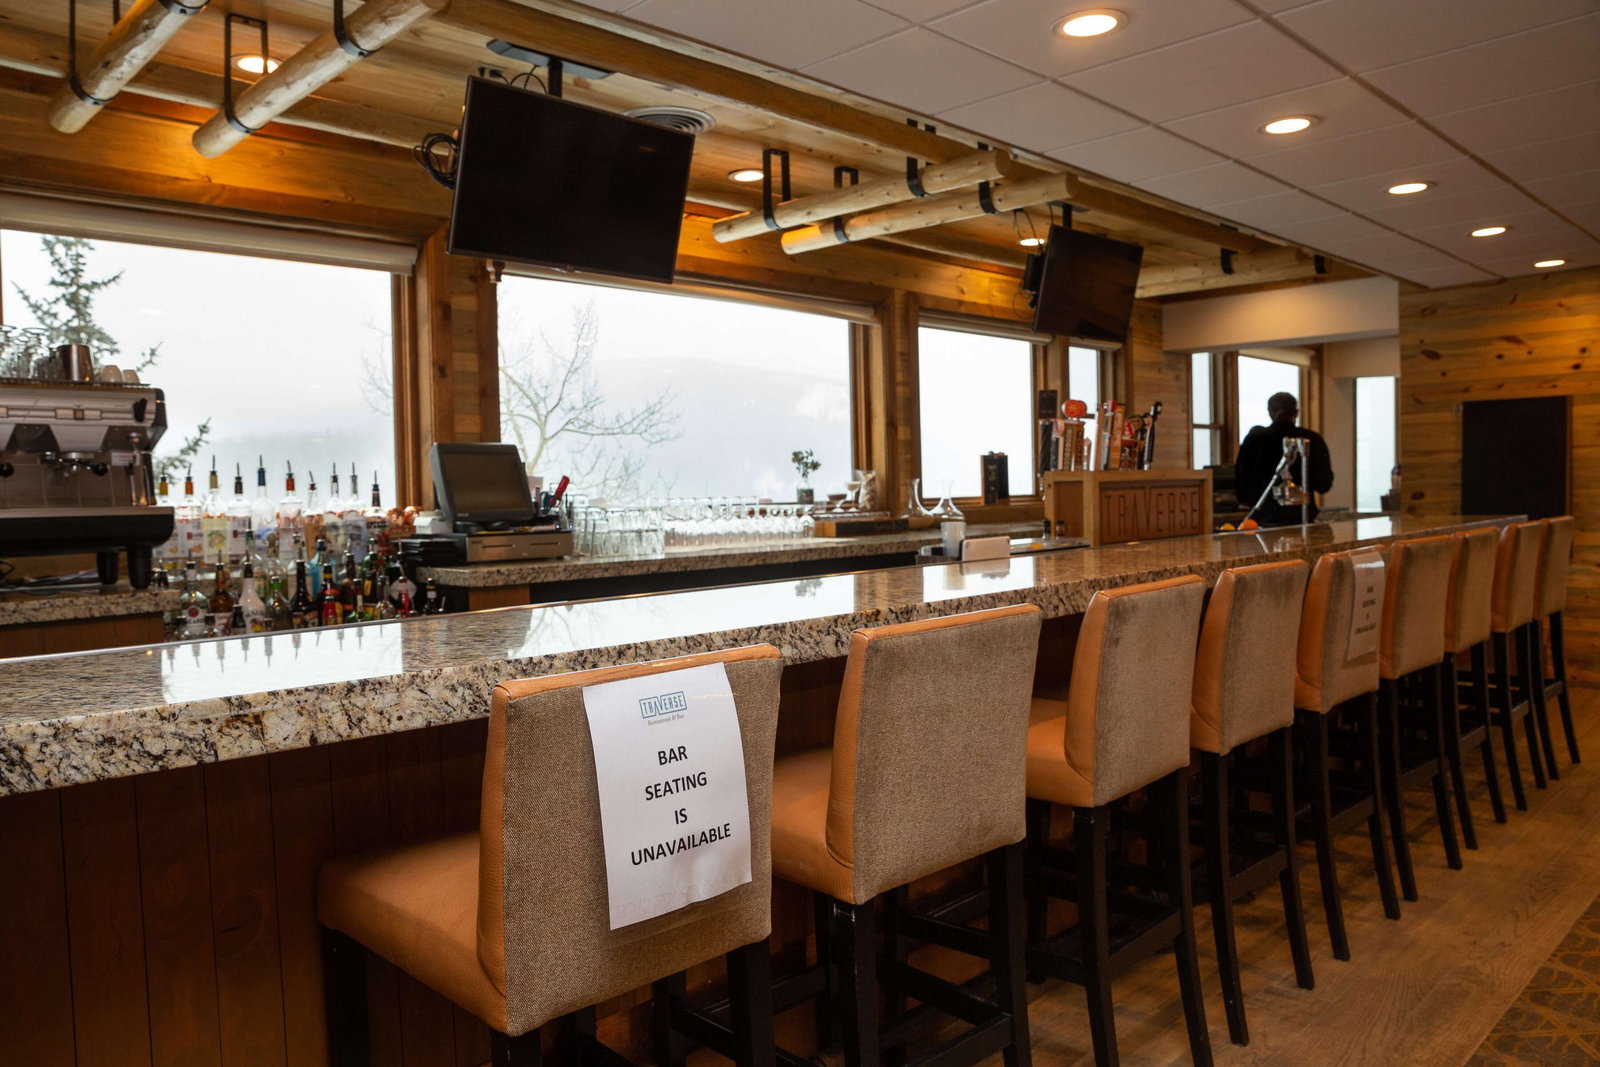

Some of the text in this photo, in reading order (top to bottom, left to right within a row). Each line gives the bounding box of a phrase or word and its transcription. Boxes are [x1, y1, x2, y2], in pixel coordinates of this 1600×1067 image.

[1104, 488, 1199, 538] TRAVERSE
[641, 694, 685, 716] TRAVERSE
[657, 745, 688, 766] BAR
[645, 771, 708, 801] SEATING
[674, 808, 688, 825] IS
[631, 823, 732, 866] UNAVAILABLE
